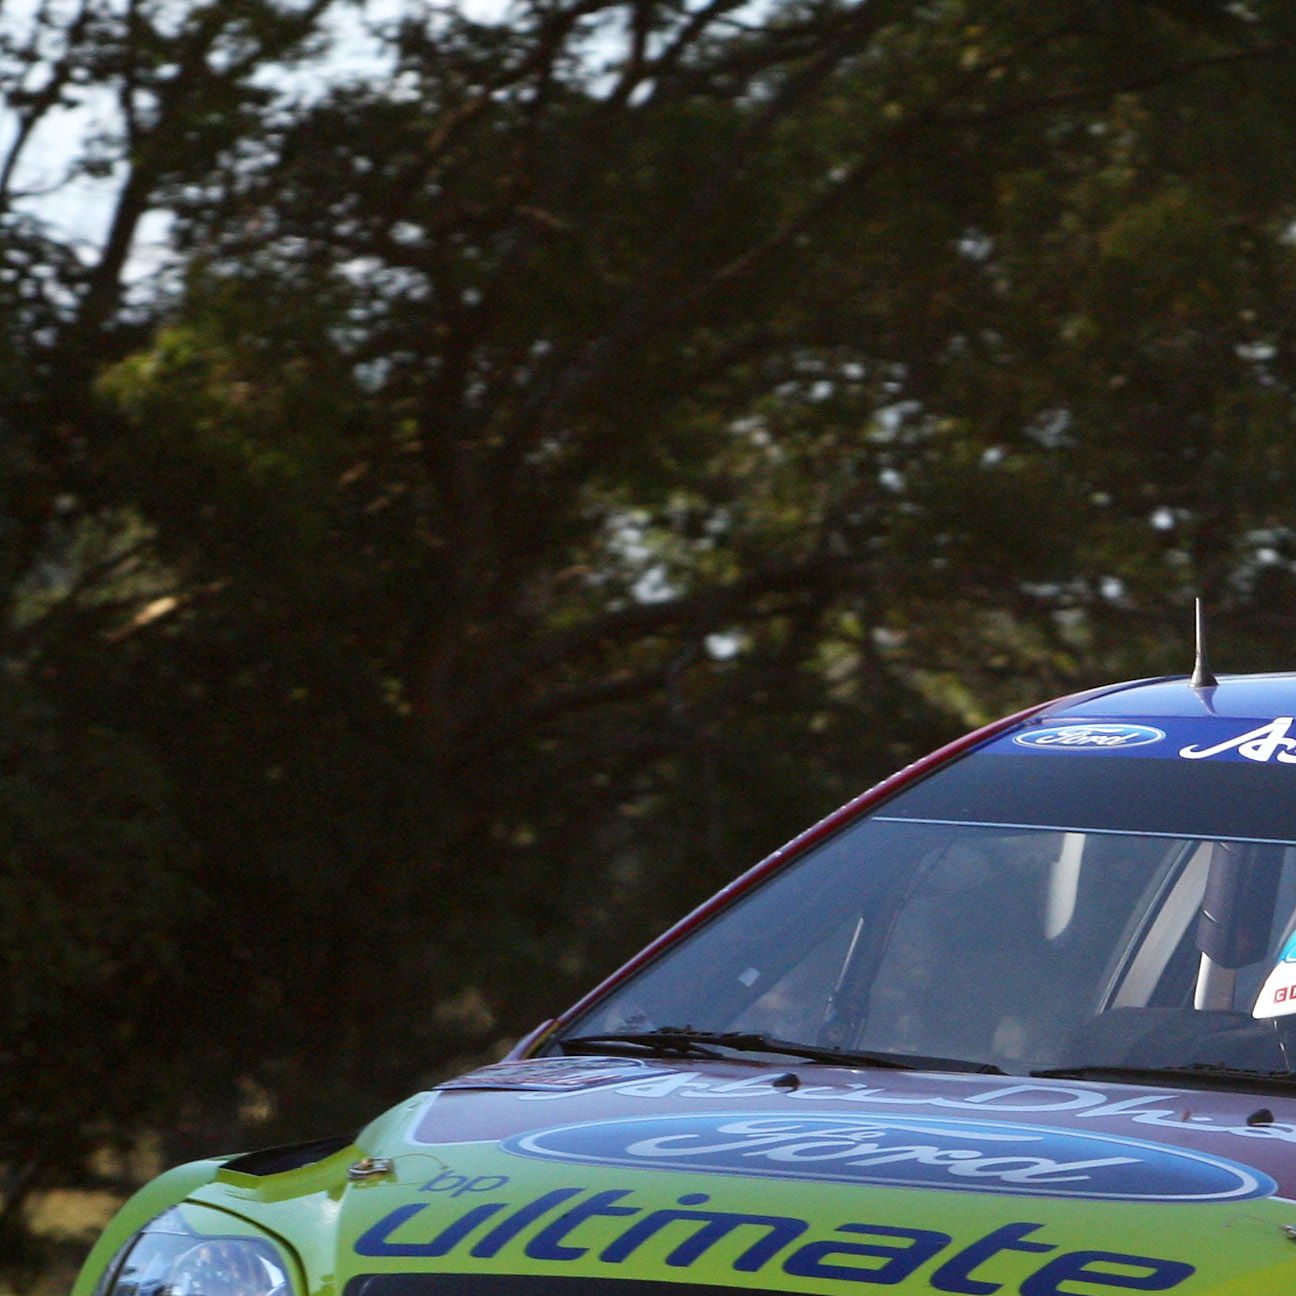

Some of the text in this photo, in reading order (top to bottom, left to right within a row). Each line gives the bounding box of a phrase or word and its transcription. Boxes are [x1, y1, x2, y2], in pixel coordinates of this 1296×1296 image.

[1033, 725, 1130, 747] Ford
[625, 1116, 1144, 1184] Ford
[419, 1169, 510, 1198] bp
